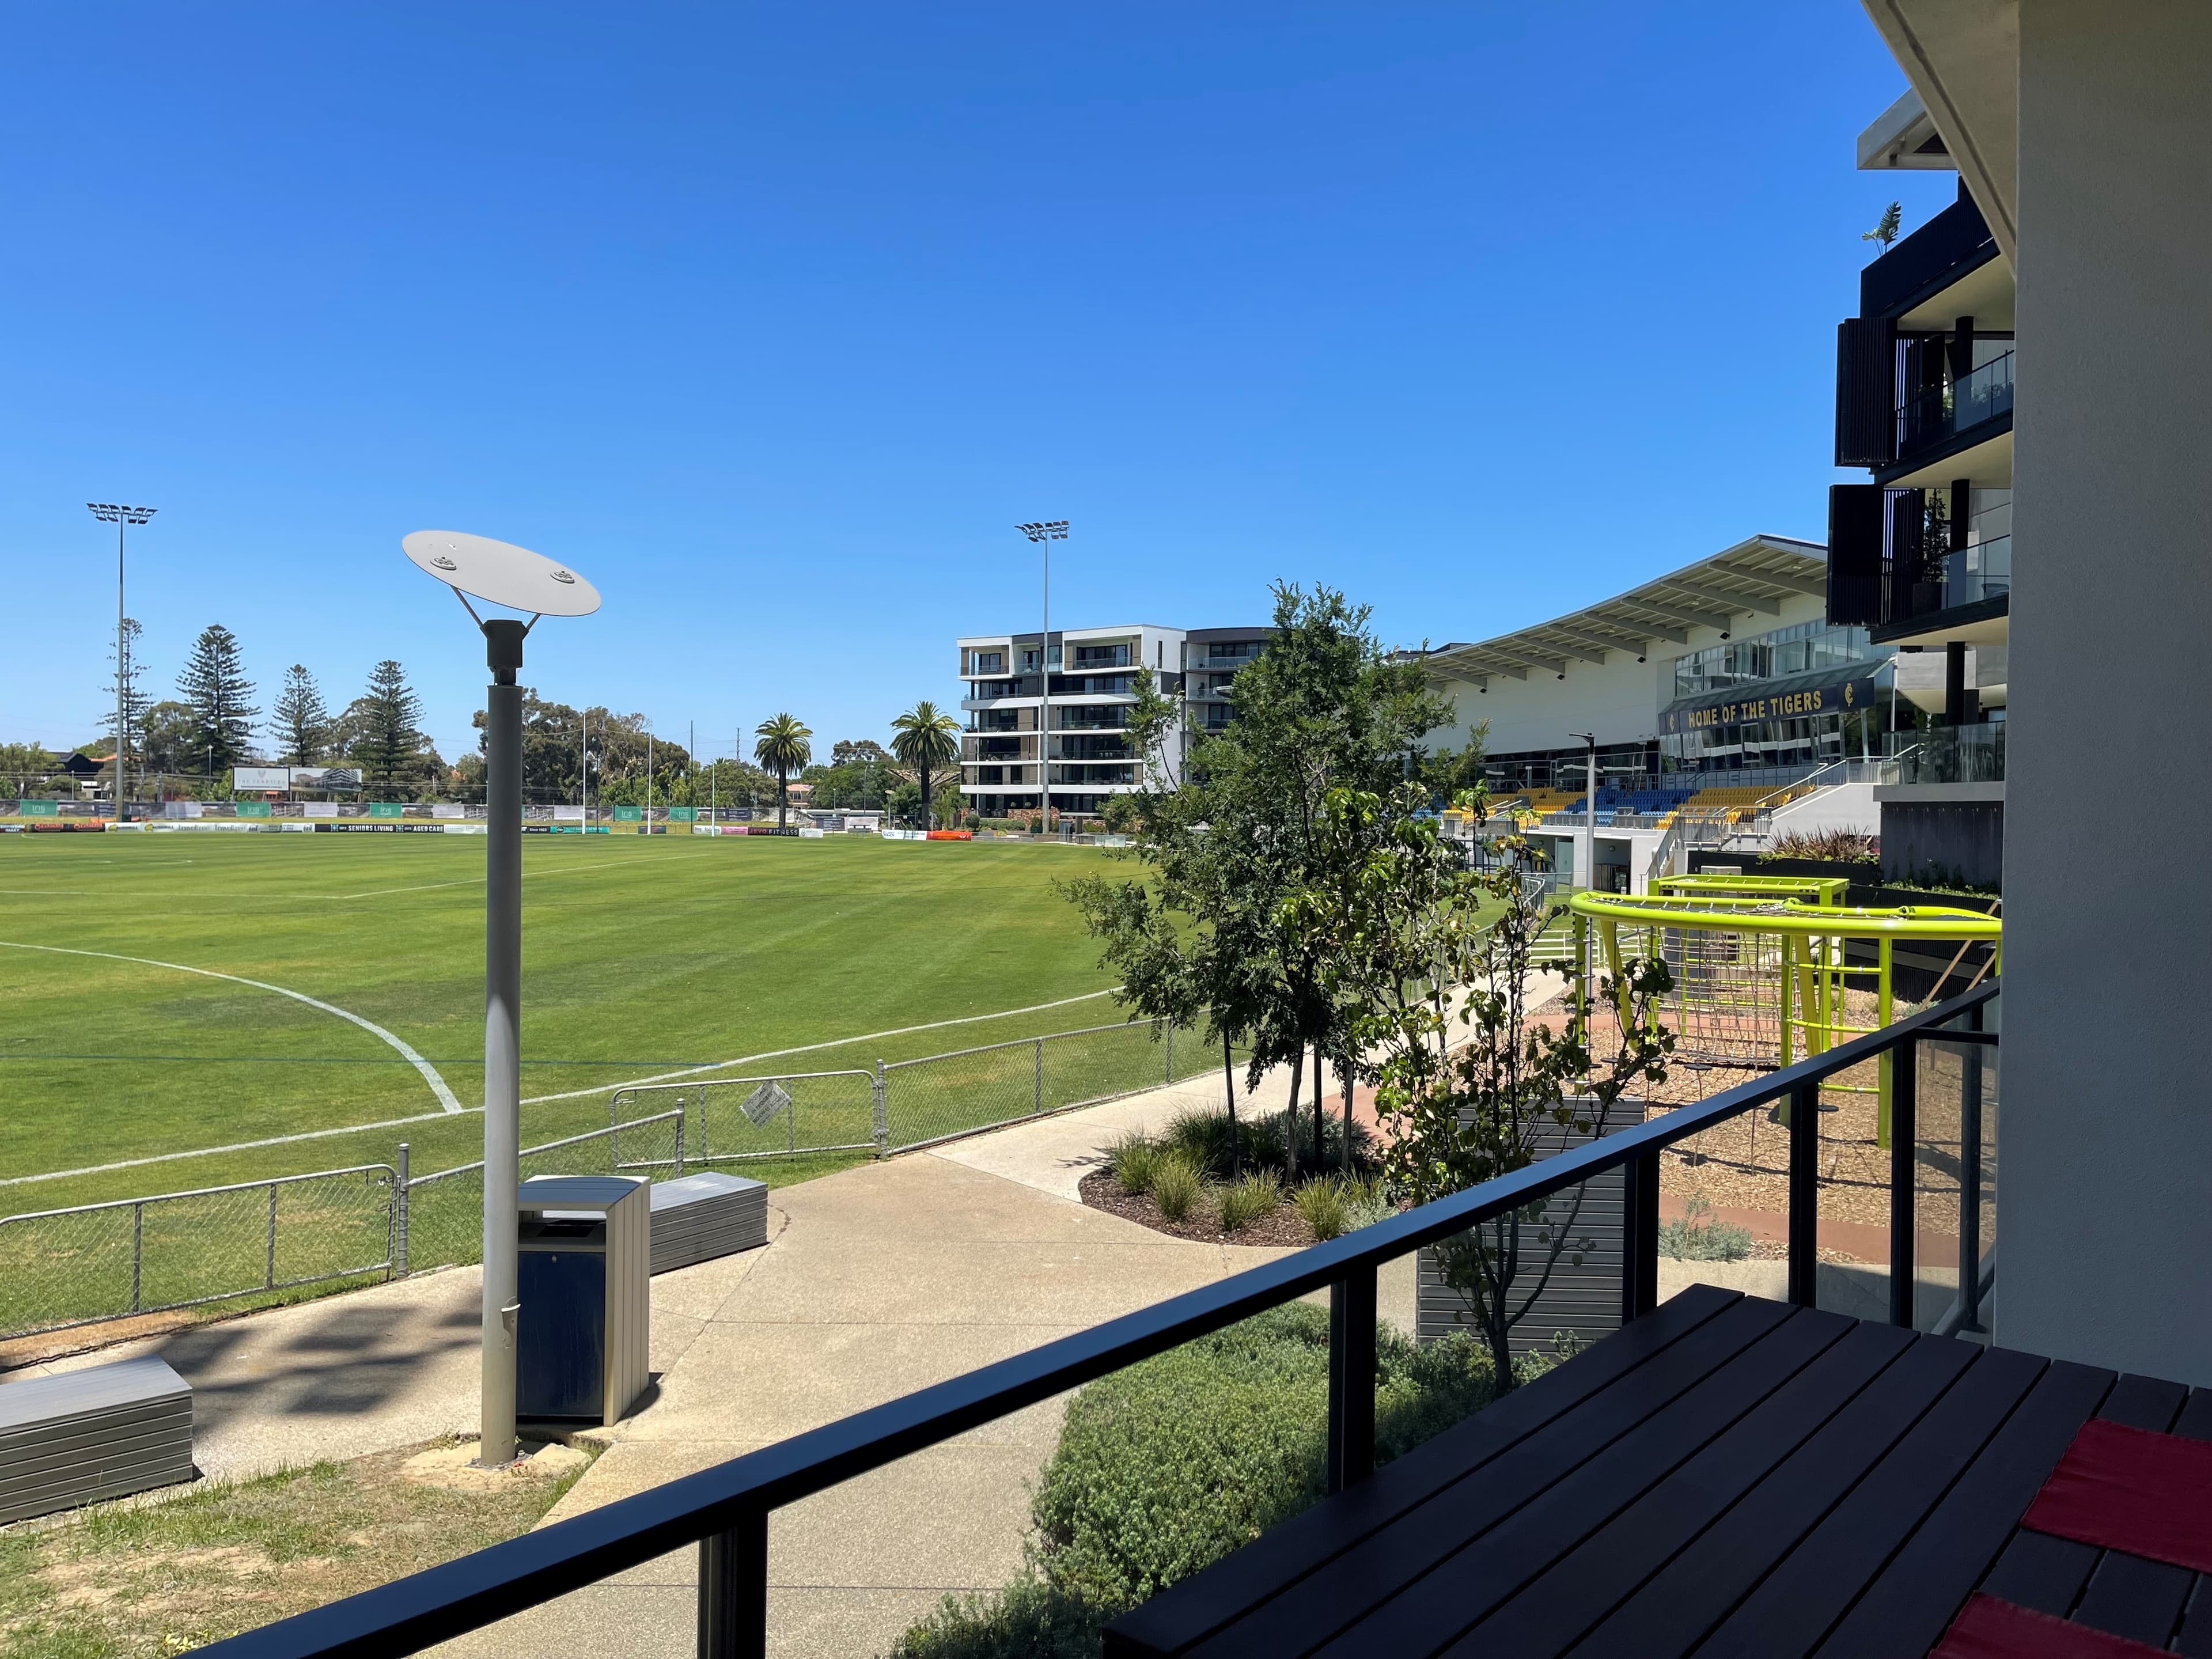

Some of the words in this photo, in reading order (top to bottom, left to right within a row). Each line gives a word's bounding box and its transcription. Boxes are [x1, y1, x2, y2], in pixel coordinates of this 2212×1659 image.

[1688, 709, 1718, 728] HOME
[1722, 704, 1736, 723] OF
[1741, 700, 1765, 719] THE
[1770, 690, 1821, 716] TIGERS
[622, 810, 632, 818] Iris
